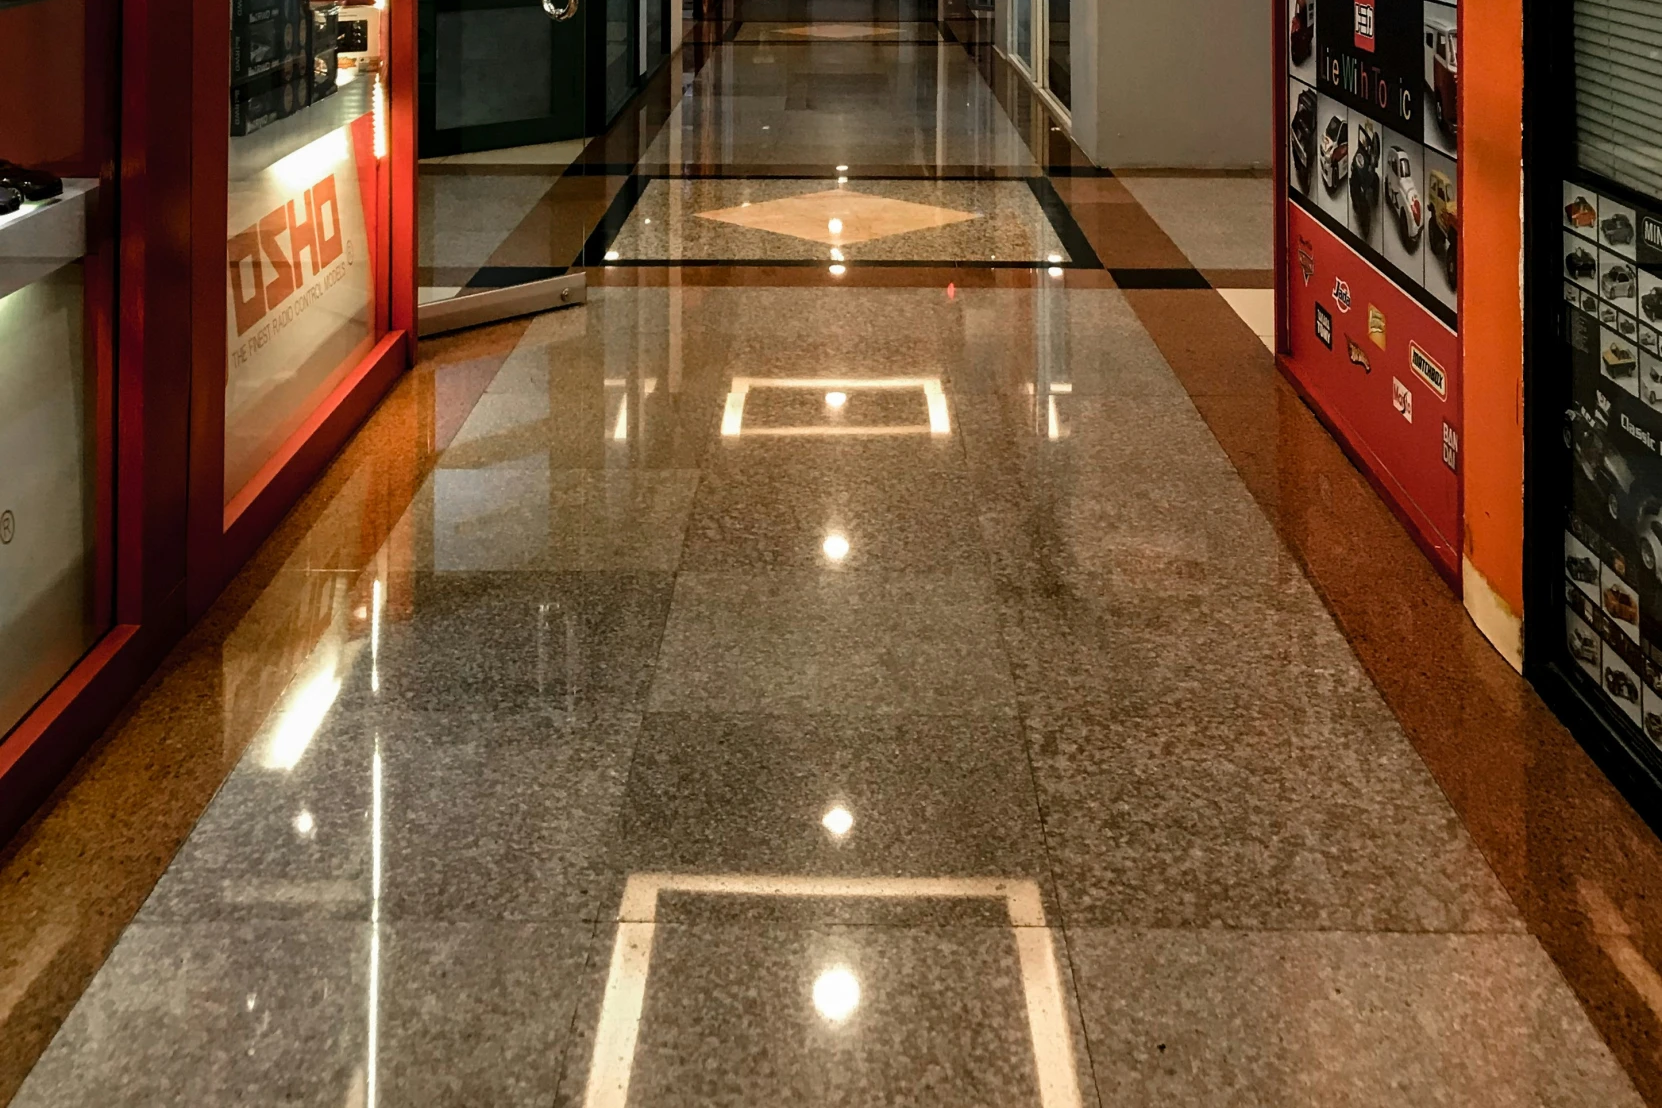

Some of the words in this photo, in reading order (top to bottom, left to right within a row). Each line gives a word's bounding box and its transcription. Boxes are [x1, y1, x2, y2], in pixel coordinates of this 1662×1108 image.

[1333, 280, 1351, 307] Jada
[231, 343, 247, 369] THE
[248, 324, 272, 358] FINEST
[272, 306, 293, 335] RADIO
[295, 281, 324, 317] CONTROL
[323, 263, 346, 292] MODELS
[1412, 351, 1444, 390] MATCHBOX
[1620, 413, 1657, 452] Classic
